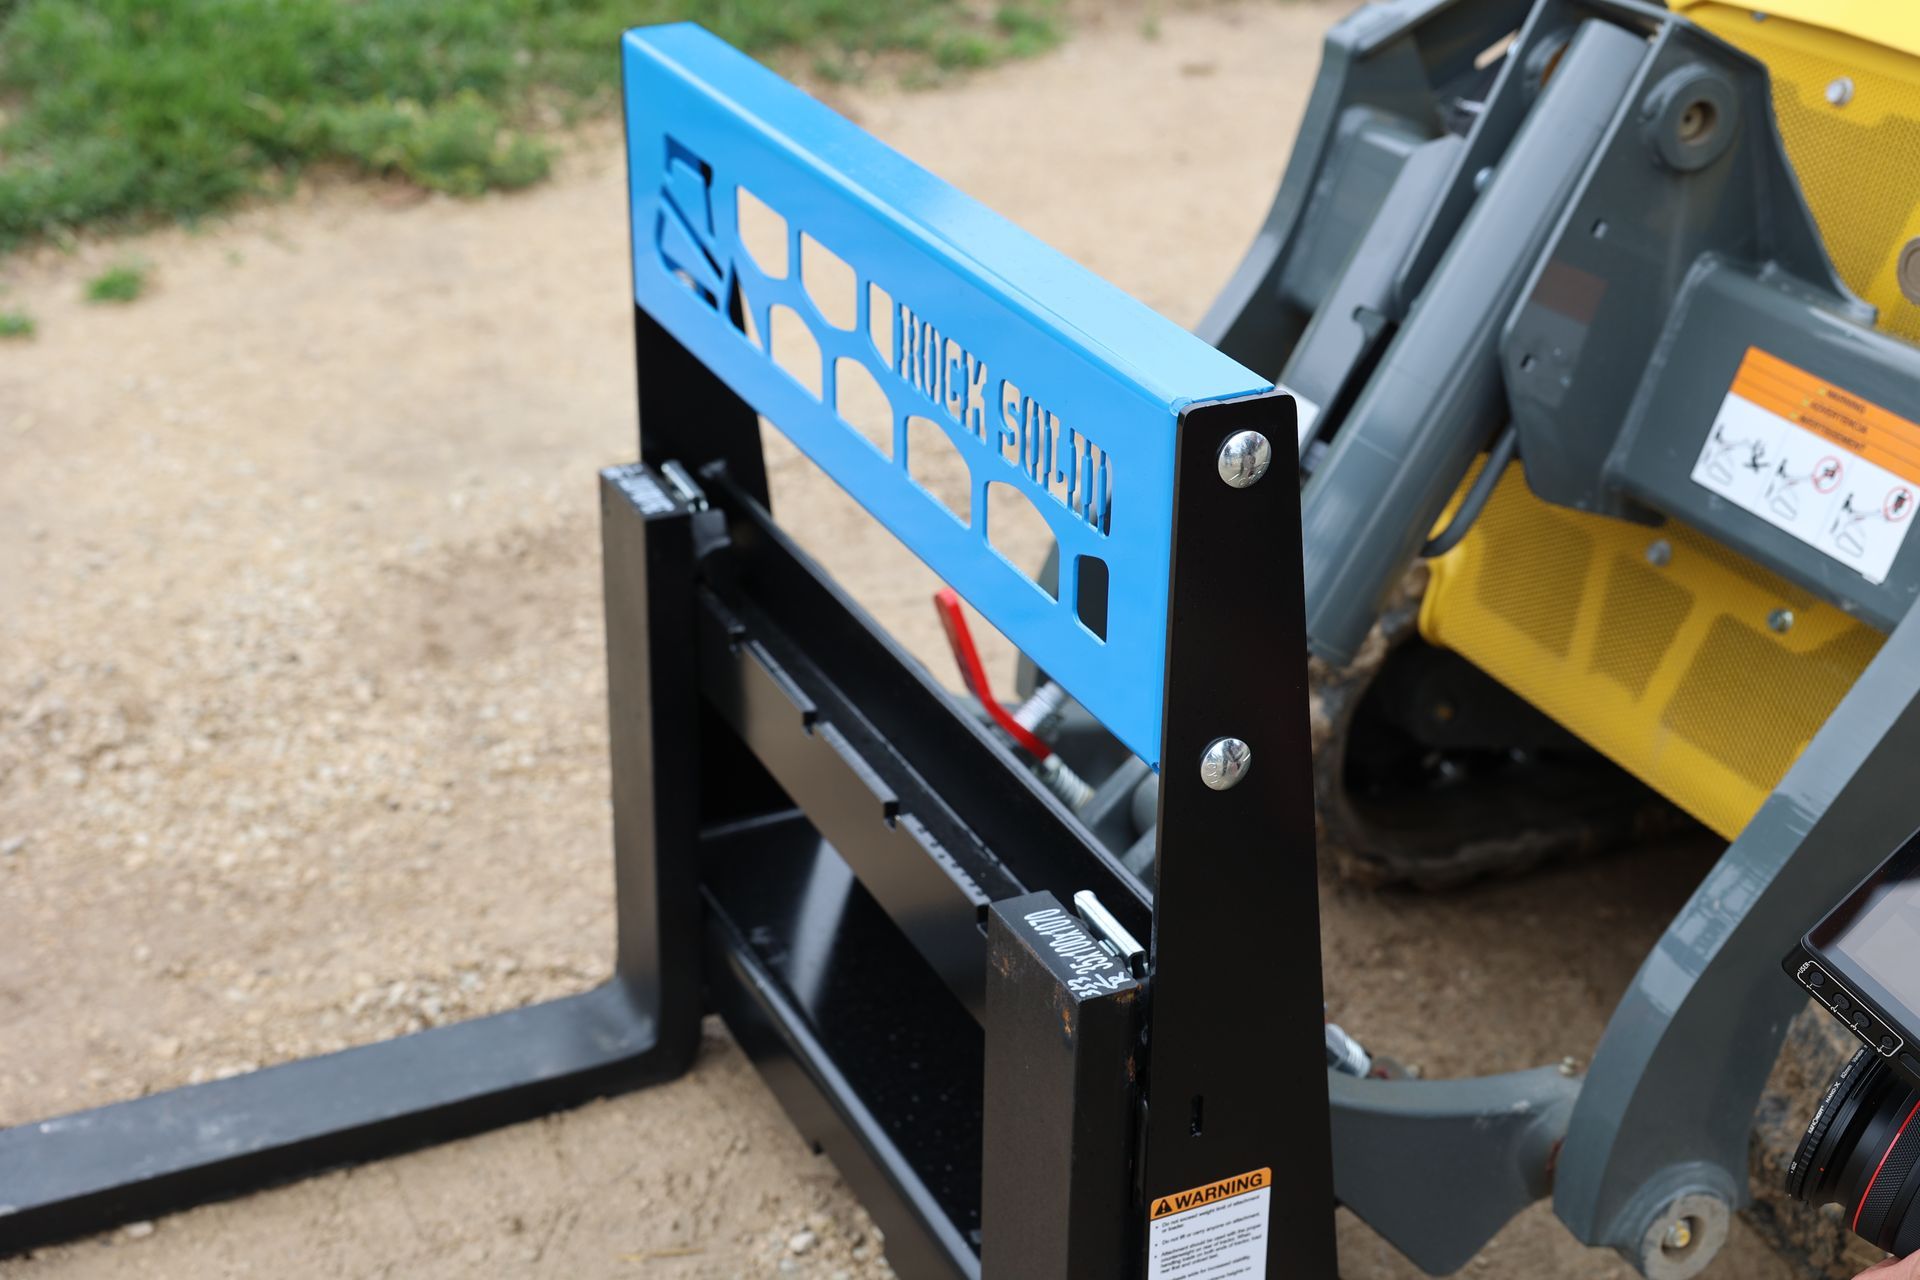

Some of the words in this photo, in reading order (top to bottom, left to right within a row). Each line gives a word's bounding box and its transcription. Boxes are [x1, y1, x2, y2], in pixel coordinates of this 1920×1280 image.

[899, 302, 987, 446] ROCK
[998, 379, 1112, 536] SOLID
[1798, 962, 1810, 974] USER
[1826, 1082, 1840, 1103] NANO-X
[1174, 1173, 1262, 1210] WARNING
